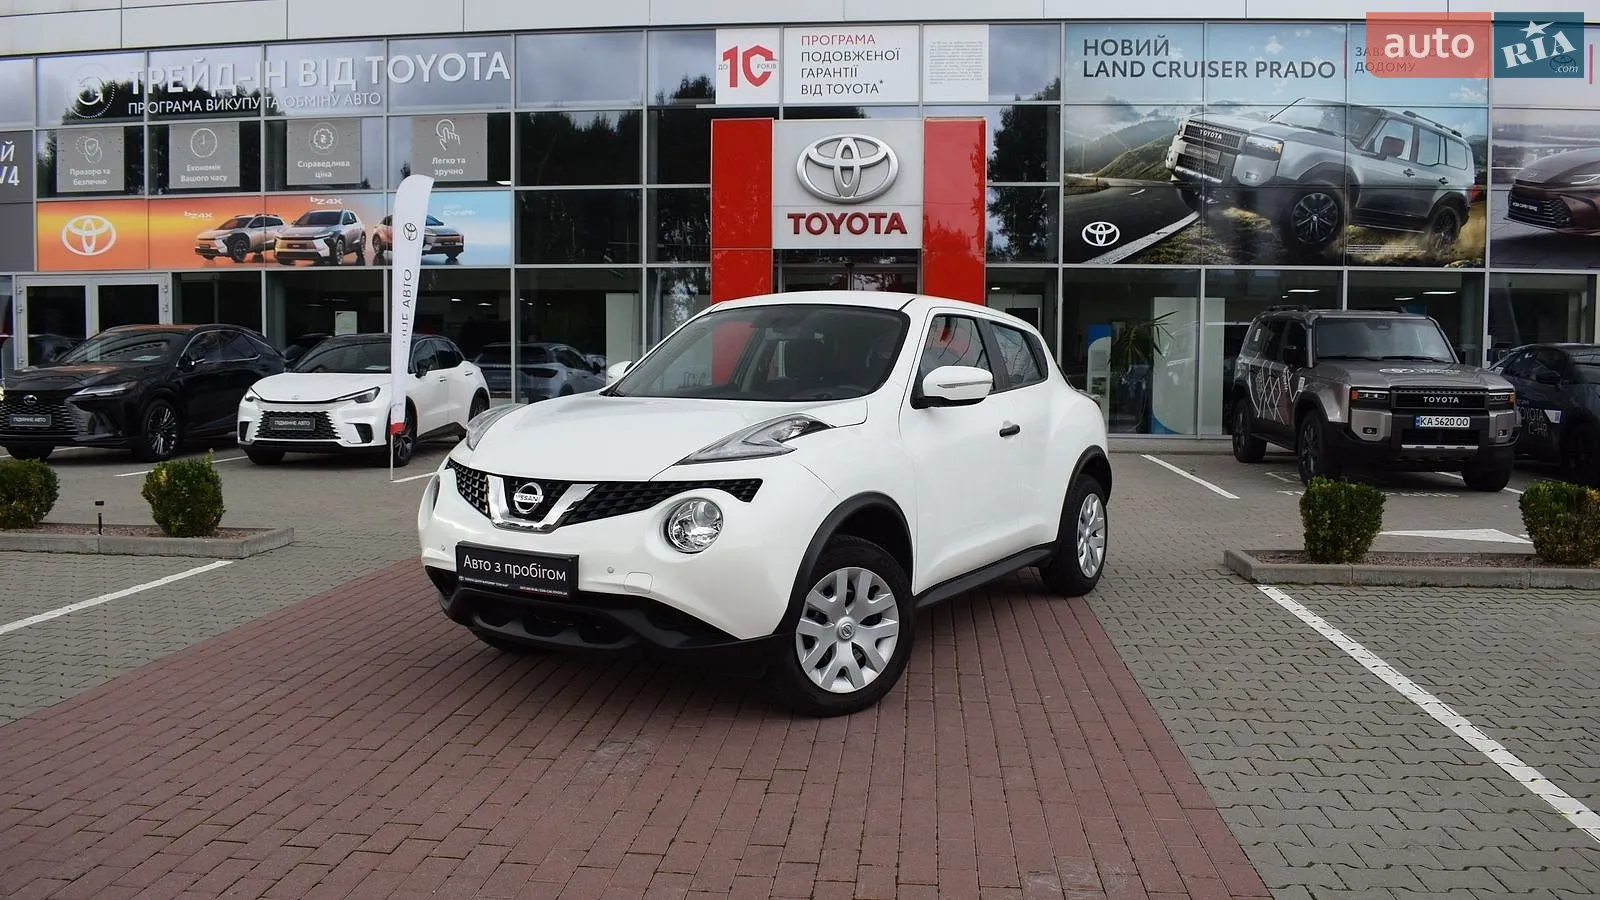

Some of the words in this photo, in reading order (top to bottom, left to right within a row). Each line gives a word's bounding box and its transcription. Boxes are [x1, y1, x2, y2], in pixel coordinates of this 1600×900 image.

[801, 34, 876, 46] ПРОГРАМА
[1083, 35, 1170, 56] НОВИЙ
[801, 47, 900, 64] ПОДОВЖЕНОЇ
[801, 64, 860, 78] ГАРАНТІЇ
[1083, 60, 1146, 78] LAND
[1152, 60, 1248, 78] CRUISER
[1255, 61, 1336, 78] PRADO
[1354, 62, 1416, 74] ДОДОМУ
[129, 56, 287, 98] ТРЕЙД-ІН
[299, 57, 357, 92] ВІД
[365, 51, 512, 85] TOYOTA
[801, 83, 823, 96] ВІД
[128, 99, 203, 116] ПРОГРАМА
[206, 96, 260, 111] ВИКУПУ
[264, 96, 281, 110] ТА
[284, 93, 342, 109] ОБМІНУ
[344, 91, 381, 106] АВТО
[1200, 129, 1223, 140] TOYOTA
[297, 160, 351, 169] Справедлива
[432, 157, 456, 165] Легко
[69, 168, 102, 177] Прозоро
[180, 175, 209, 183] Вашого
[210, 174, 228, 183] часу
[315, 171, 333, 179] ціна
[434, 168, 464, 177] зручно
[787, 212, 908, 235] TOYOTA
[1420, 417, 1433, 426] KA
[1434, 417, 1455, 427] 5620
[463, 554, 492, 572] Авто
[494, 563, 501, 573] з
[504, 563, 566, 582] пробігом
